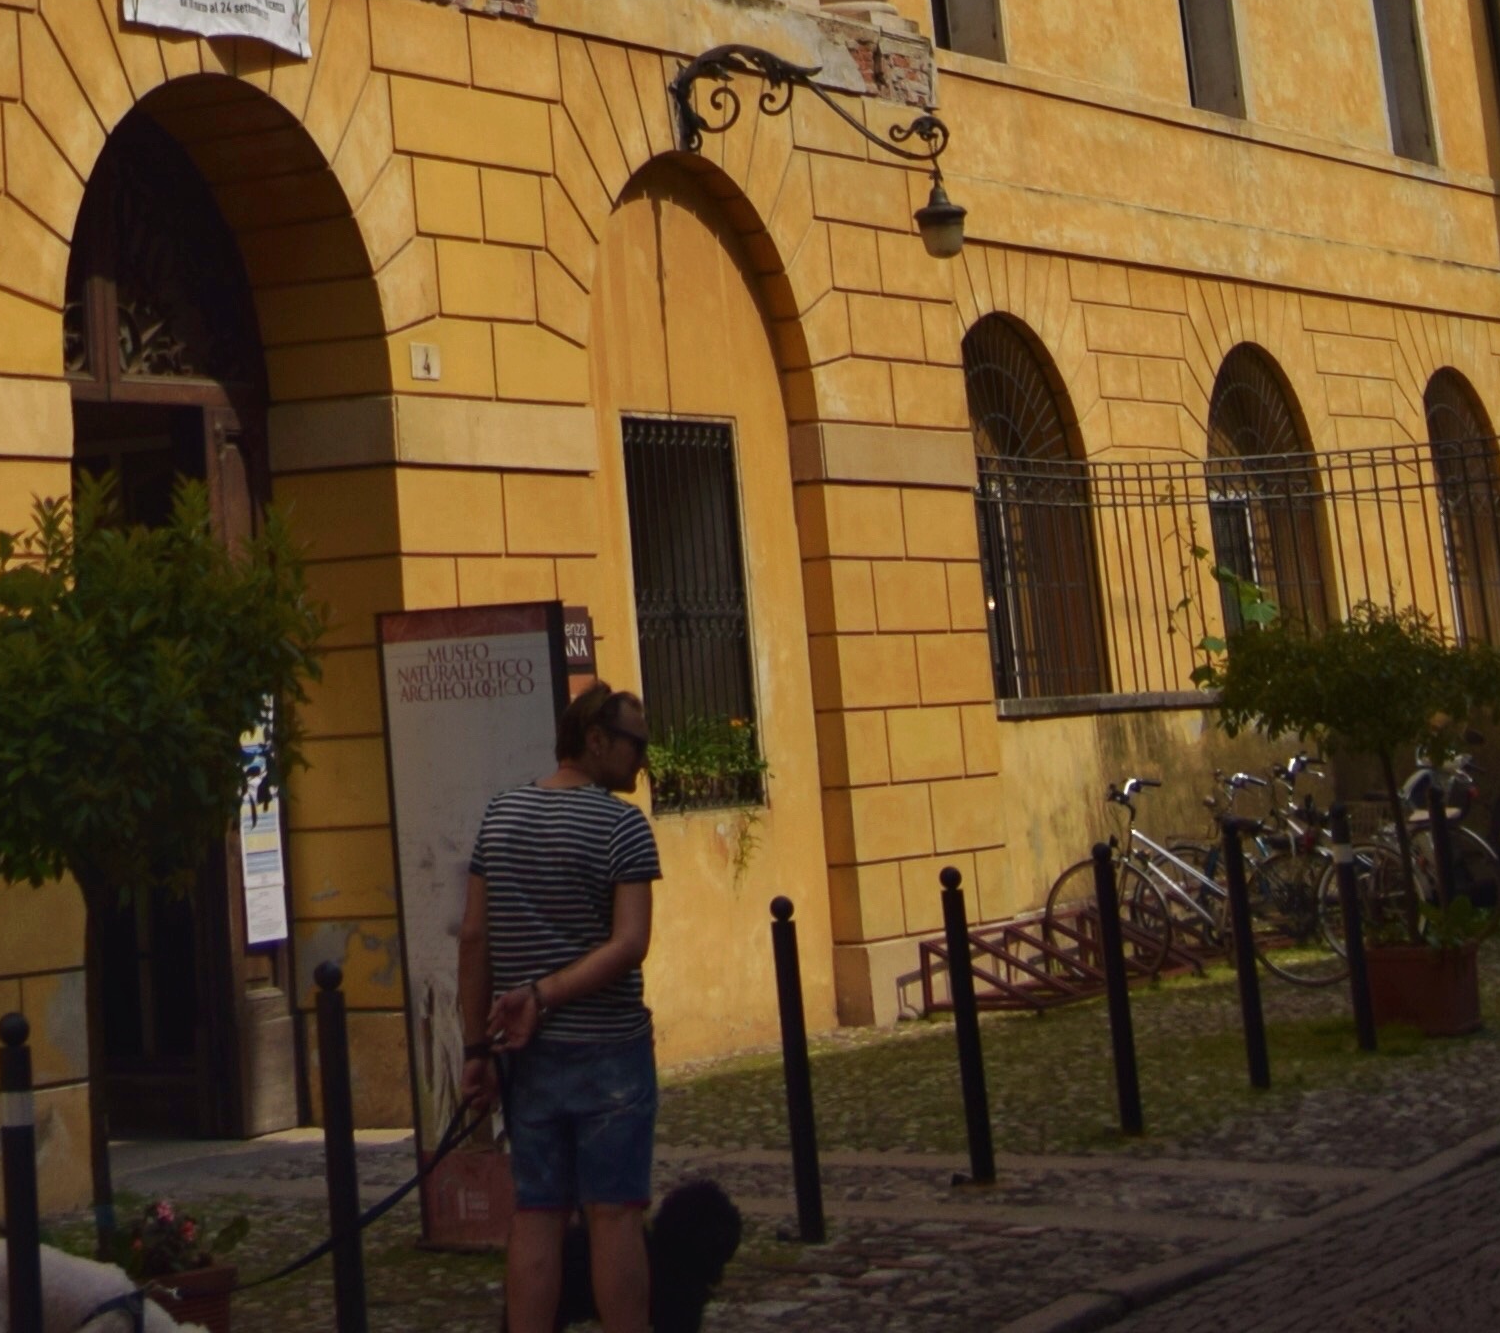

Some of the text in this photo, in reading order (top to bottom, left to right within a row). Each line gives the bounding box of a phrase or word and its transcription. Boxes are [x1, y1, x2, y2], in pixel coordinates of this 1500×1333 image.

[209, 2, 218, 13] al
[221, 2, 232, 13] 24
[427, 643, 489, 664] MUSEO
[397, 658, 533, 685] NATURALISTICO
[400, 677, 535, 702] ARCHEOLOGICO
